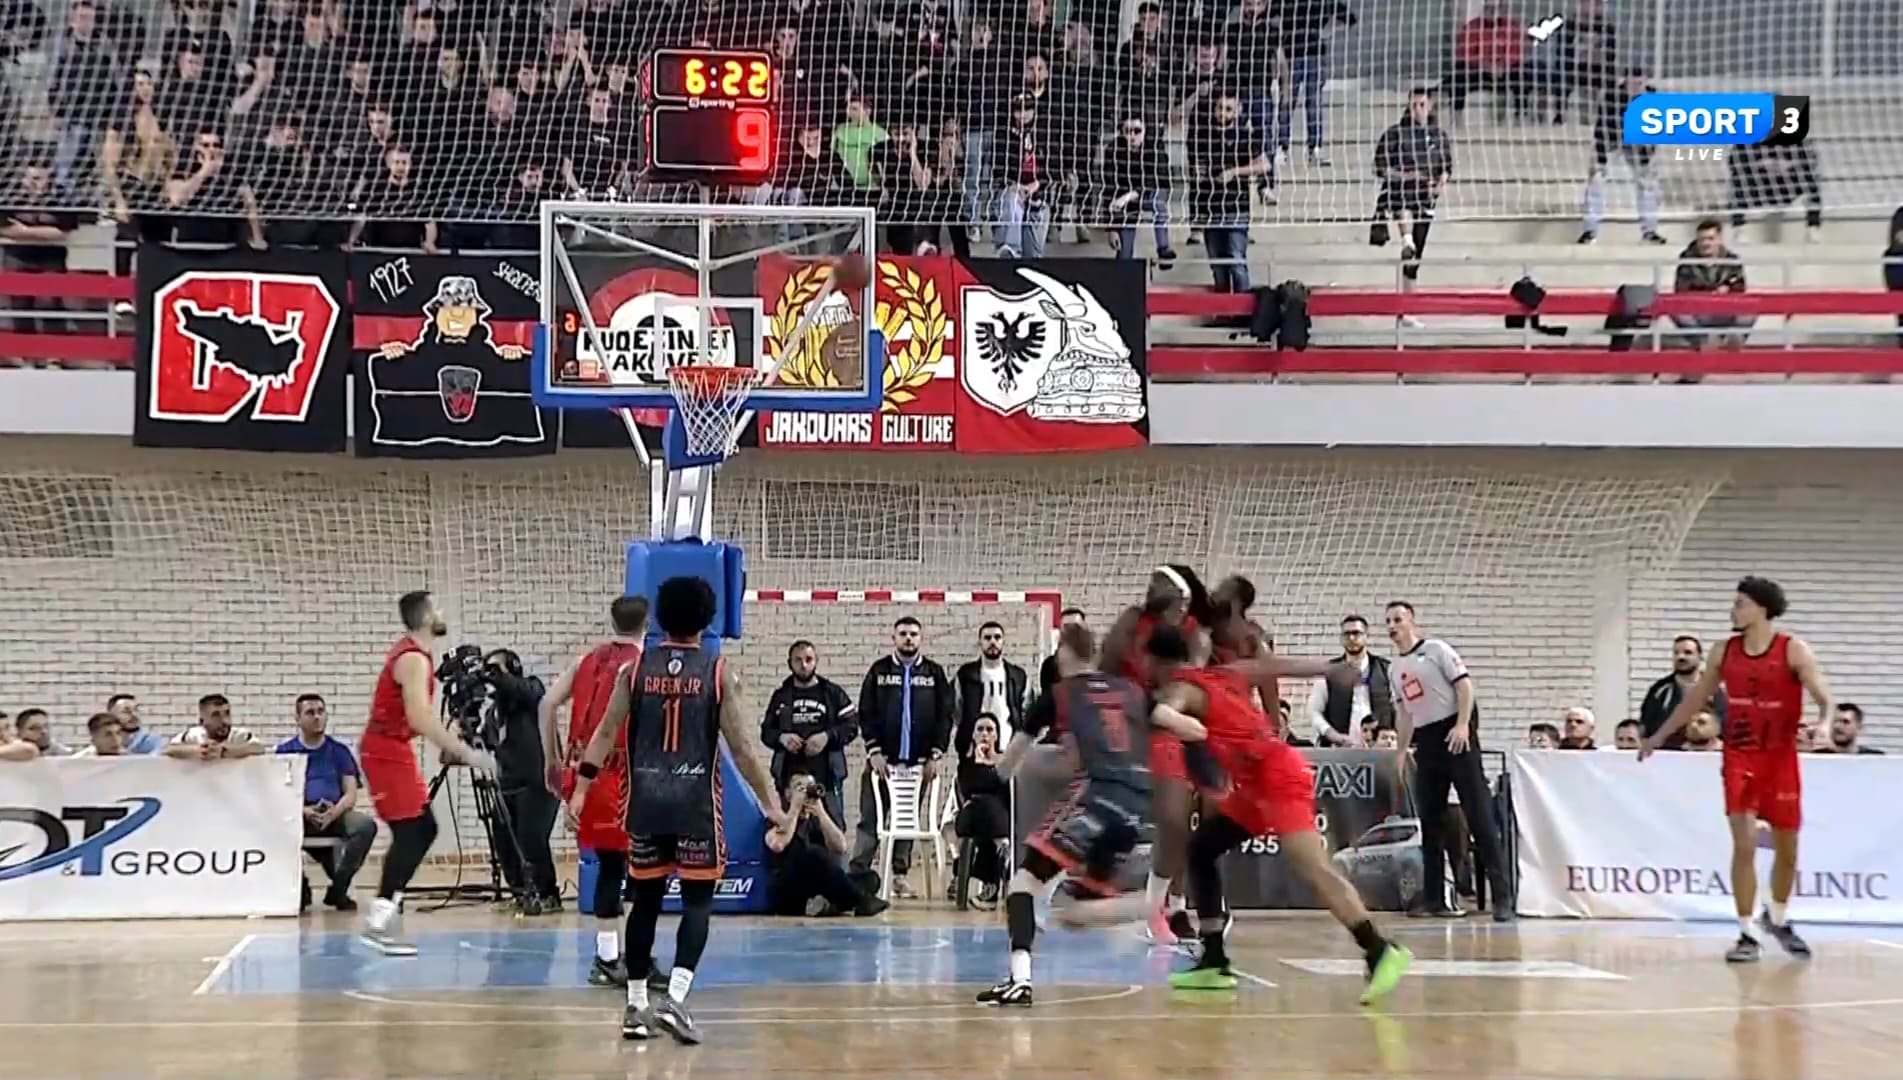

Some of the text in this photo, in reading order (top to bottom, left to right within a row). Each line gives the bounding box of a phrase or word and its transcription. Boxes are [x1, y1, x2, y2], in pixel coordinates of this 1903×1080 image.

[685, 58, 768, 97] 6:22
[737, 113, 768, 170] 9
[369, 257, 414, 303] 1927
[644, 676, 702, 695] GREEN JR
[662, 698, 681, 753] 11
[111, 850, 266, 876] GROUP
[1567, 865, 1889, 900] EUROPEA LINIC
